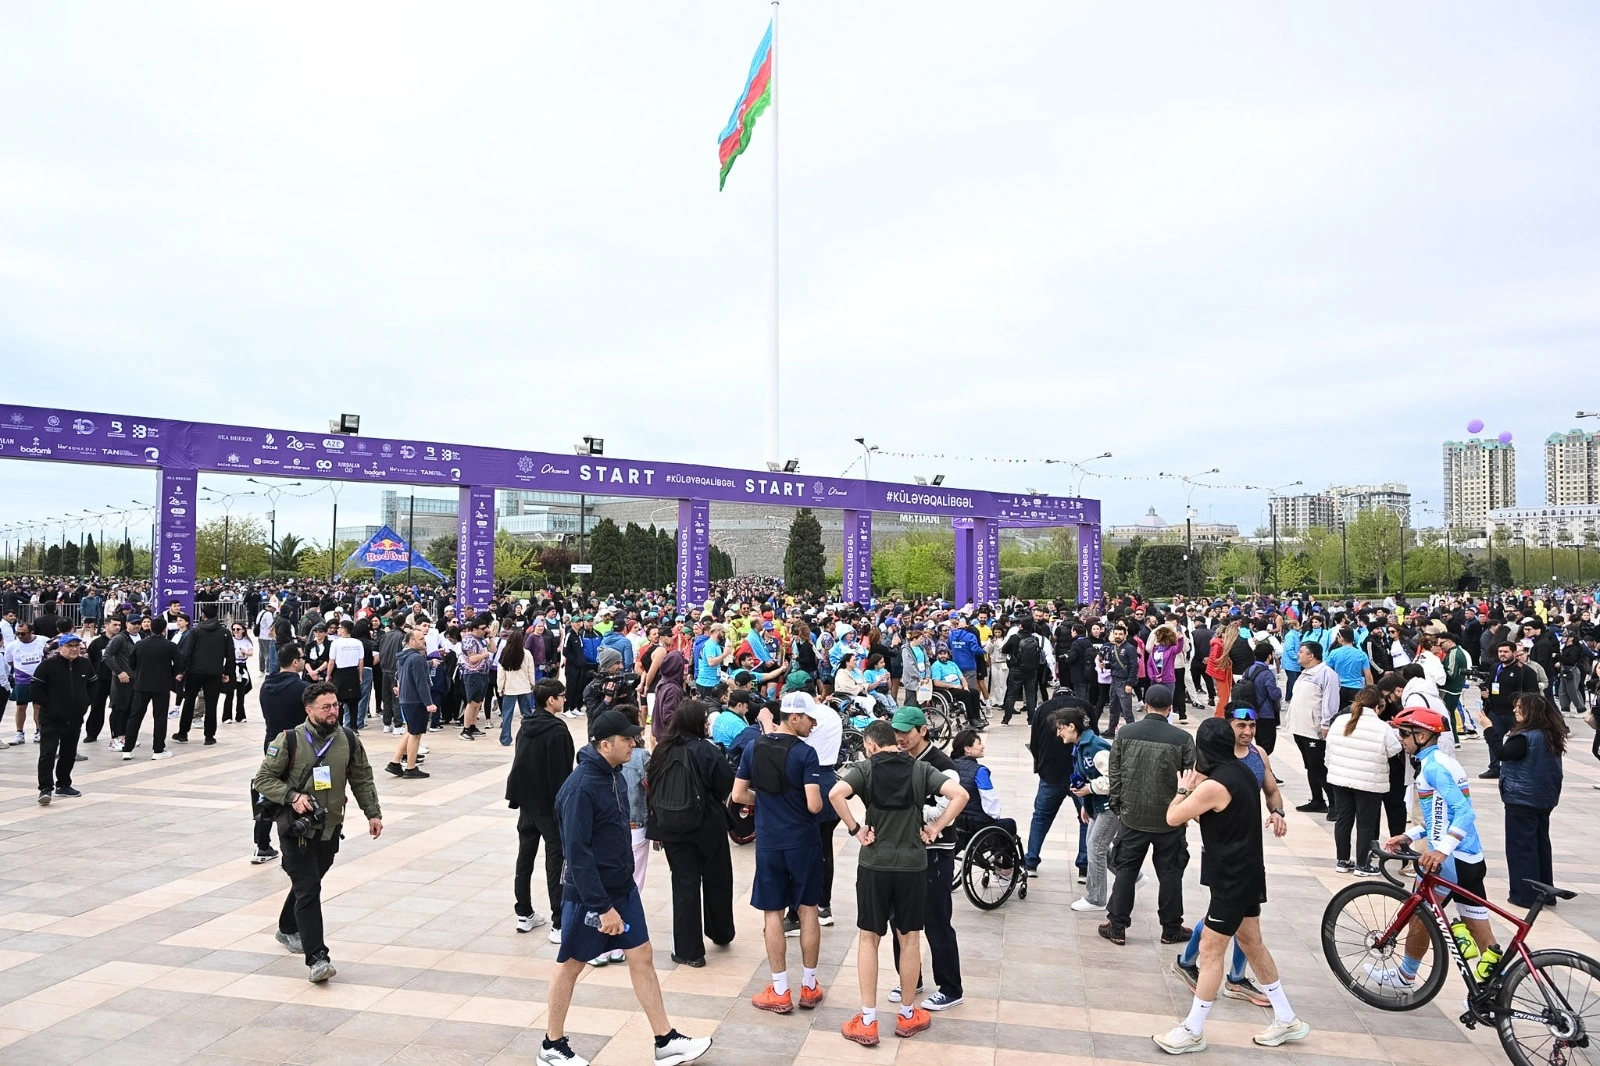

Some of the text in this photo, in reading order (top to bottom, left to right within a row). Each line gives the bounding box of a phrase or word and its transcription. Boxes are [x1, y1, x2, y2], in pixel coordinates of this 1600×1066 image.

[101, 448, 120, 456] TAN
[326, 440, 342, 448] AZE
[579, 464, 656, 485] START
[744, 478, 806, 497] START
[886, 489, 975, 508] #KÜLƏYƏQALİBGƏL
[366, 550, 410, 562] Red Bull
[1433, 796, 1444, 842] AZERBAIJAN
[1429, 903, 1471, 978] S-WORKS
